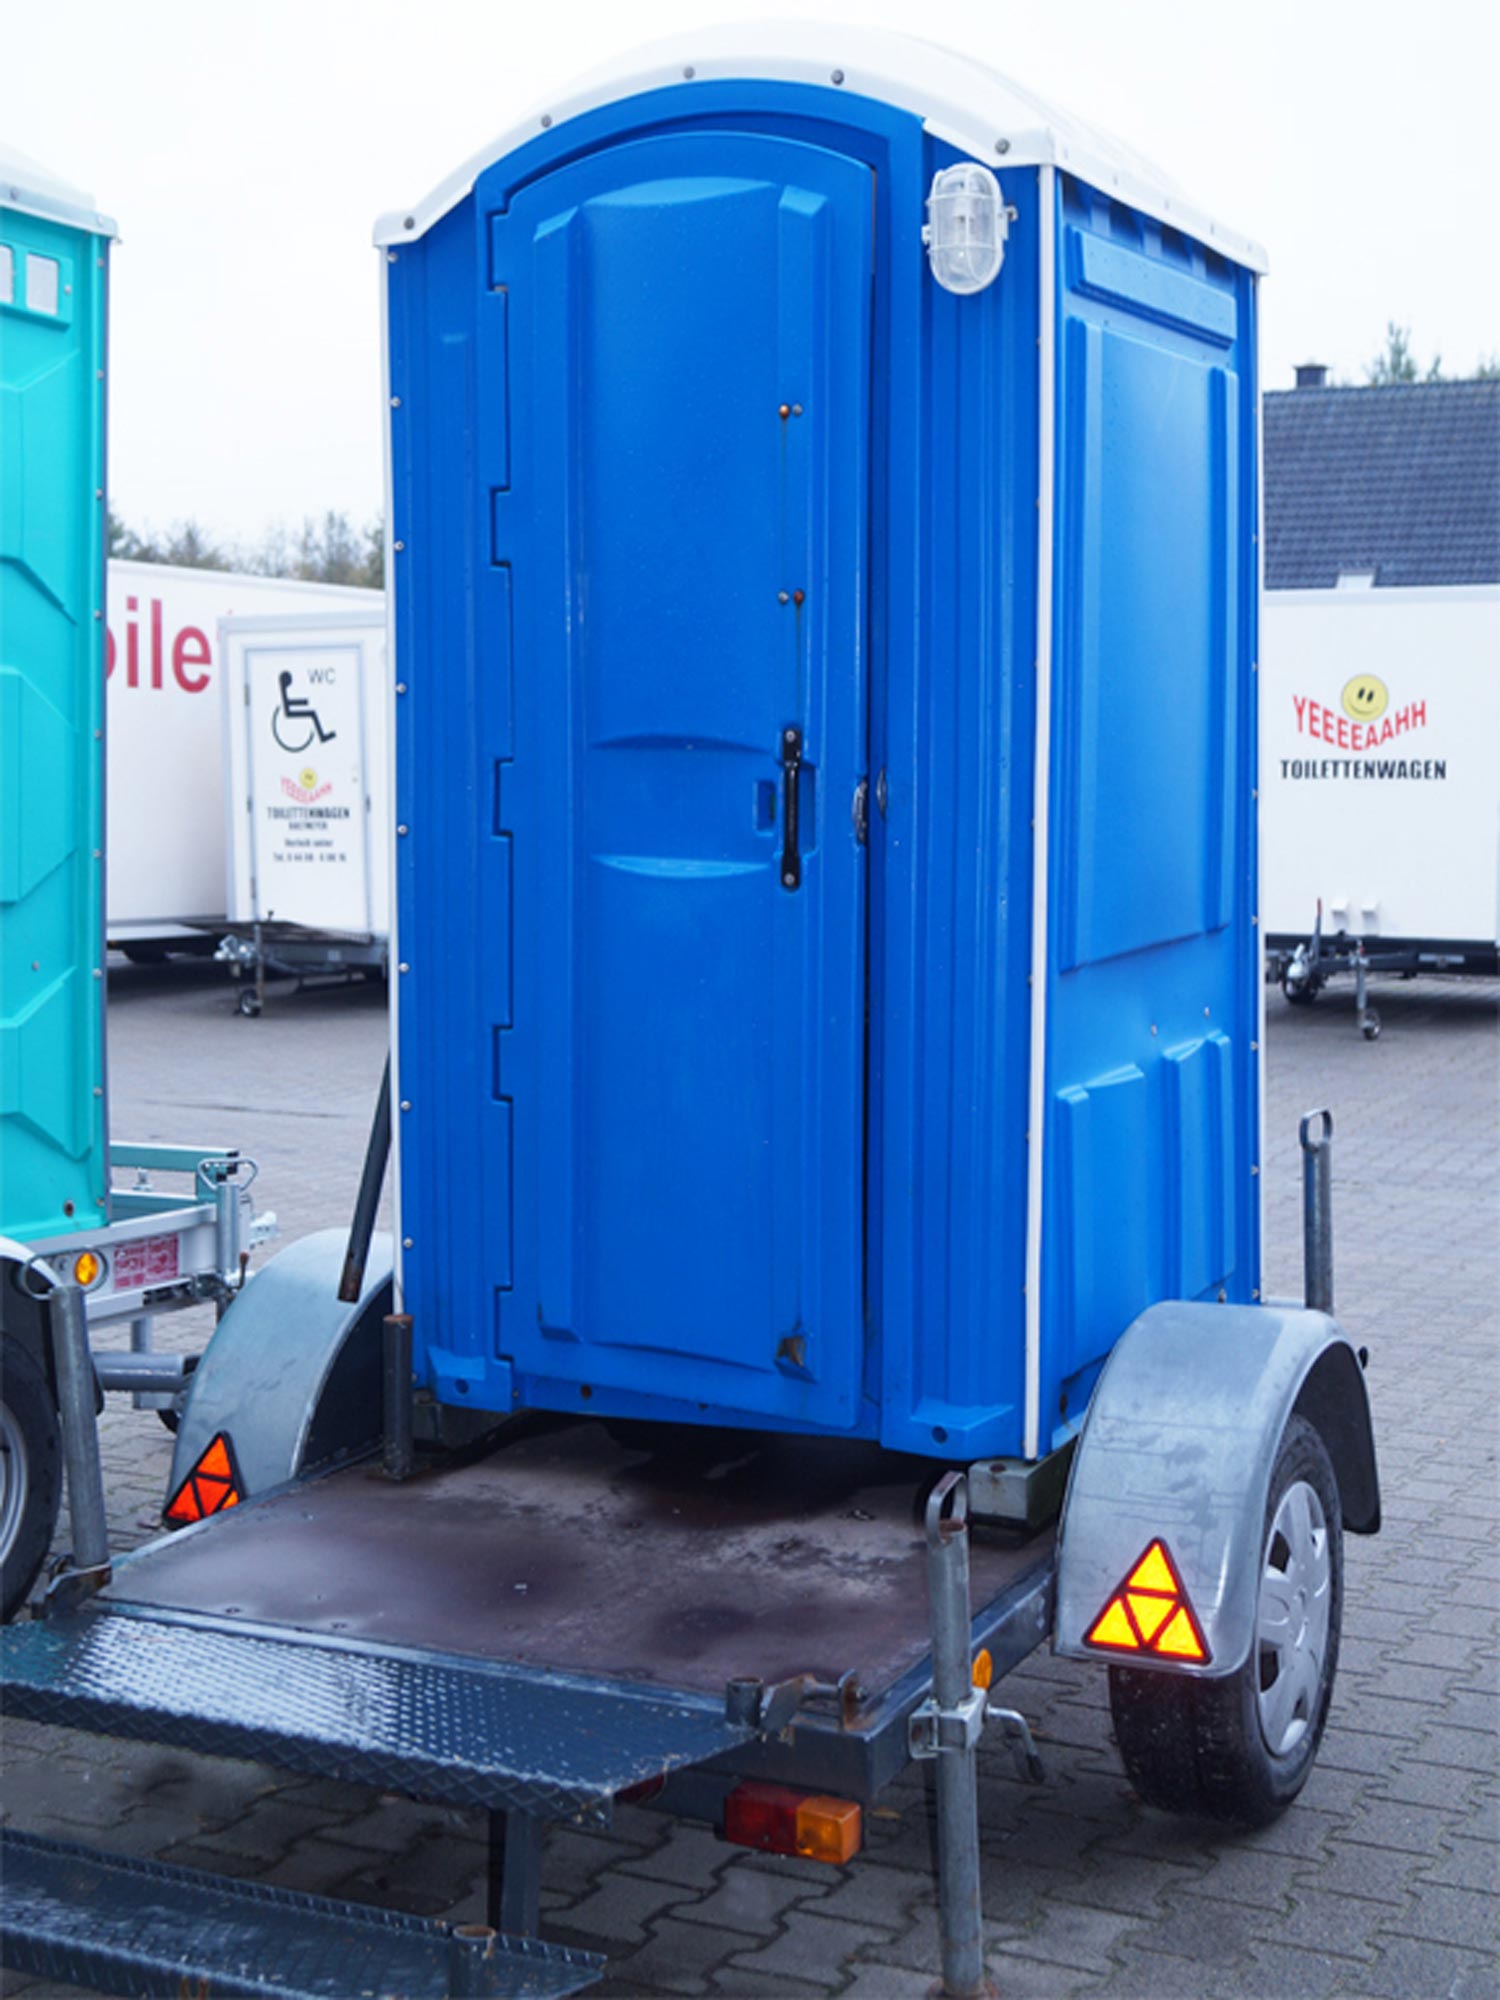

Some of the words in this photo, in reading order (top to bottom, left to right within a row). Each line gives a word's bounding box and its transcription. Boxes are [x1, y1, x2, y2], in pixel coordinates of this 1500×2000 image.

[308, 668, 336, 685] WC
[1293, 695, 1426, 751] YEEEEAAHH
[1281, 759, 1446, 780] TOILETTENWAGEN
